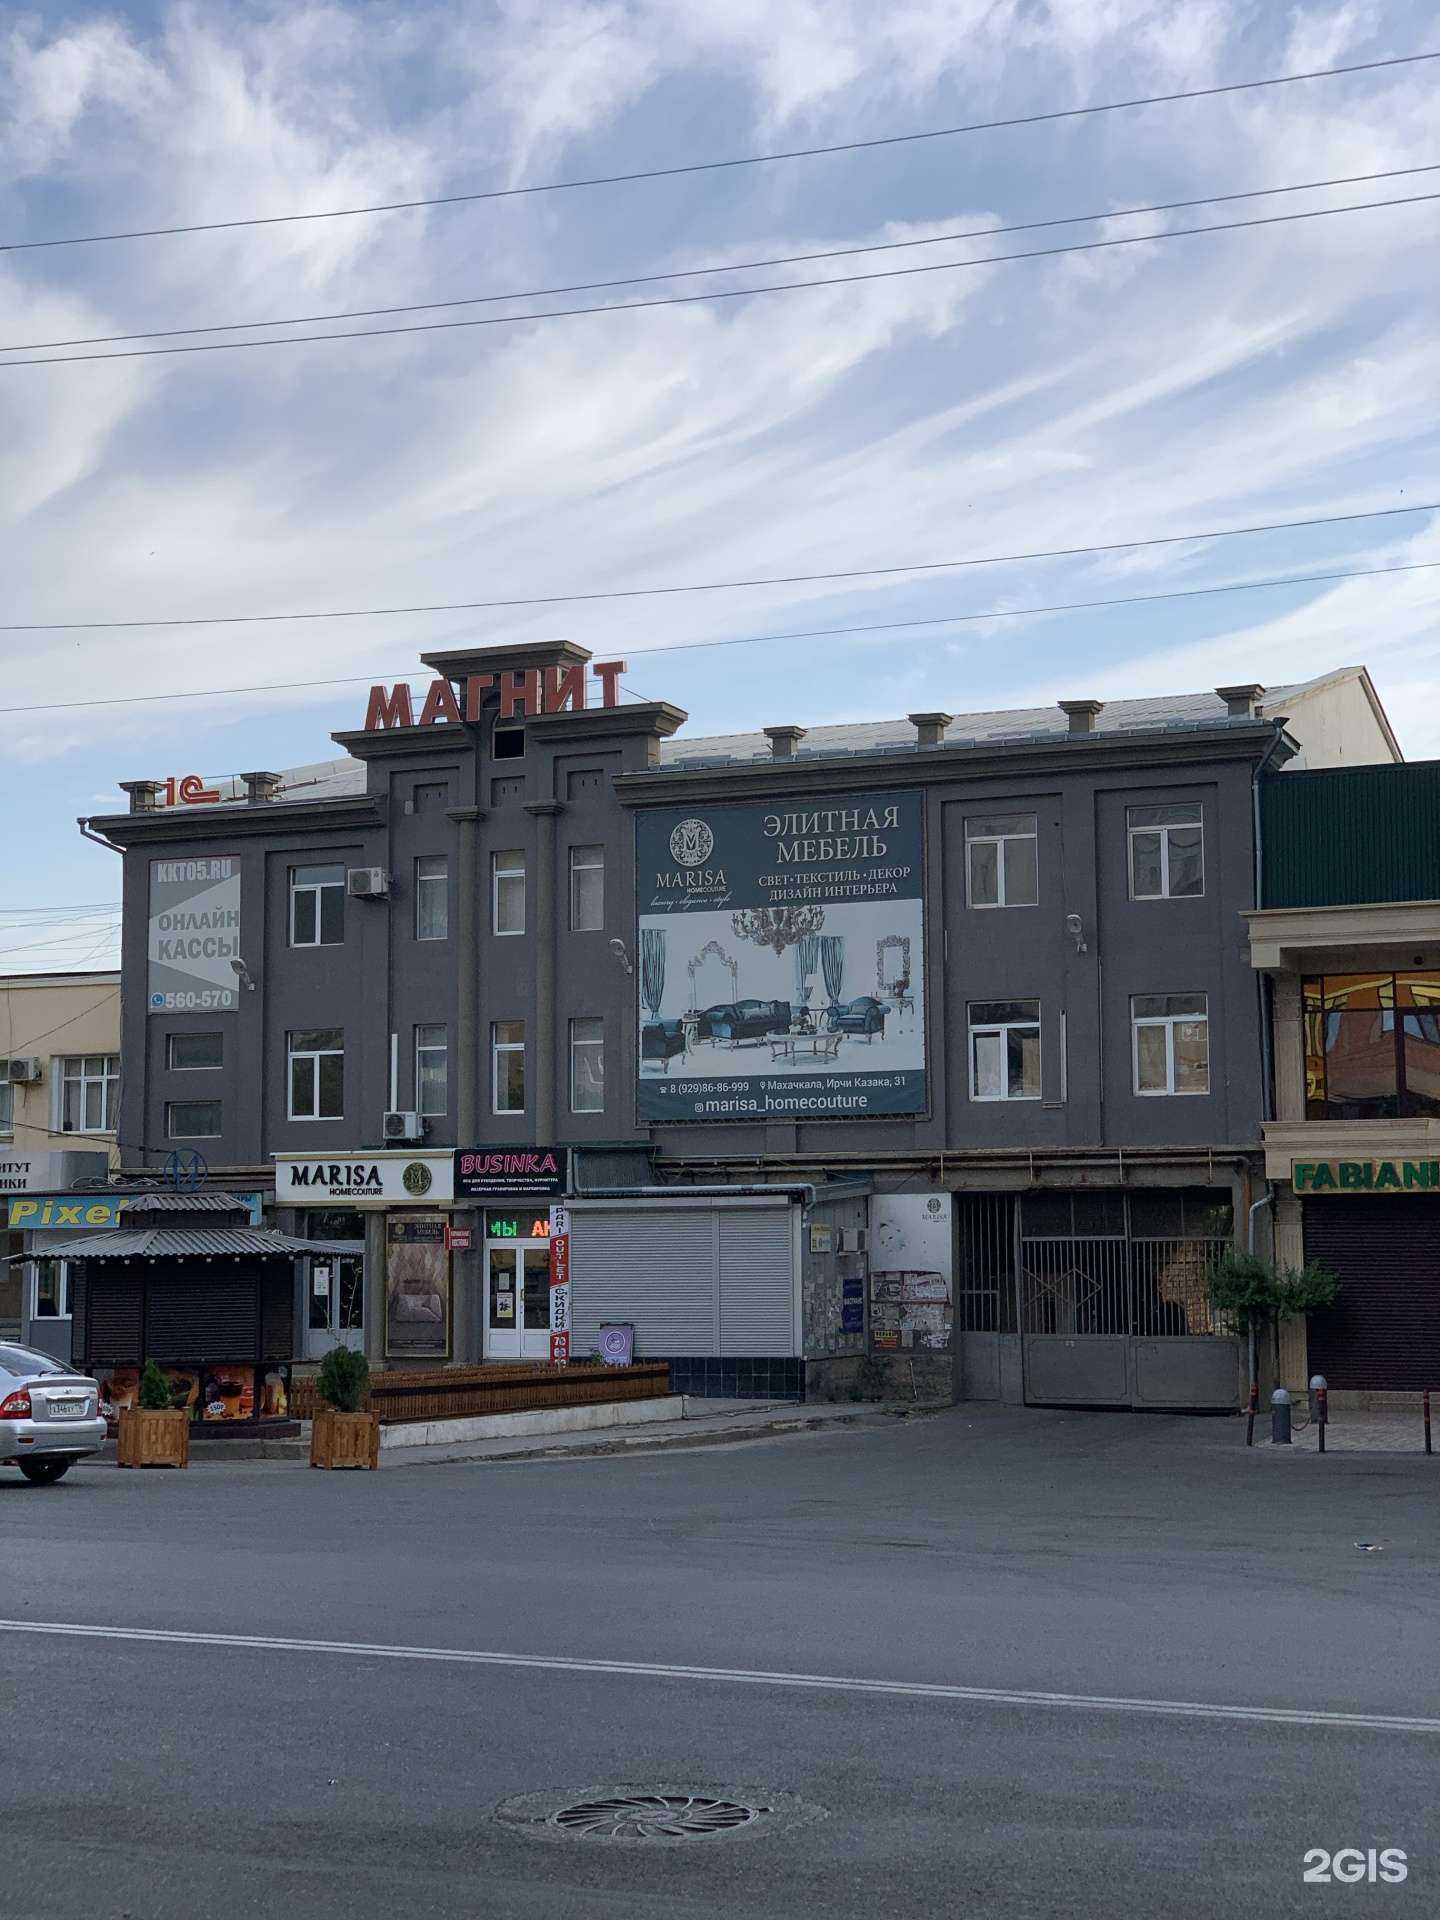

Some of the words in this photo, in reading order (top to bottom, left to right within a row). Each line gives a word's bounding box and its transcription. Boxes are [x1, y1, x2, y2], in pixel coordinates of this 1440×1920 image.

[364, 660, 628, 730] МАГНИТ
[763, 806, 900, 837] ЭЛИТНАЯ
[776, 835, 888, 863] МЕБЕЛЬ
[656, 869, 727, 888] MARISA
[758, 874, 790, 887] СВЕТ
[793, 870, 861, 884] ТЕКСТИЛЬ
[868, 866, 911, 881] ДЕКОР
[686, 885, 727, 894] HOMECOUTURE
[769, 885, 821, 902] ДИЗАЙН
[825, 882, 898, 897] ИНТЕРЬЕРА
[158, 906, 240, 932] ОНЛАЙН
[158, 935, 239, 961] КАССЫ
[164, 990, 232, 1009] 560-570
[670, 1084, 677, 1094] 8
[678, 1082, 750, 1096] (929)86-86-999
[767, 1080, 824, 1091] Махачкала,
[826, 1078, 852, 1090] Ирчи
[854, 1077, 892, 1088] Казака,
[894, 1076, 906, 1087] 31
[705, 1094, 868, 1113] marisa_homecouture
[461, 1154, 557, 1175] BUSINKA
[1294, 1160, 1440, 1190] FABIANI
[290, 1164, 384, 1187] MARISA
[329, 1187, 384, 1196] HOMECOUTURE
